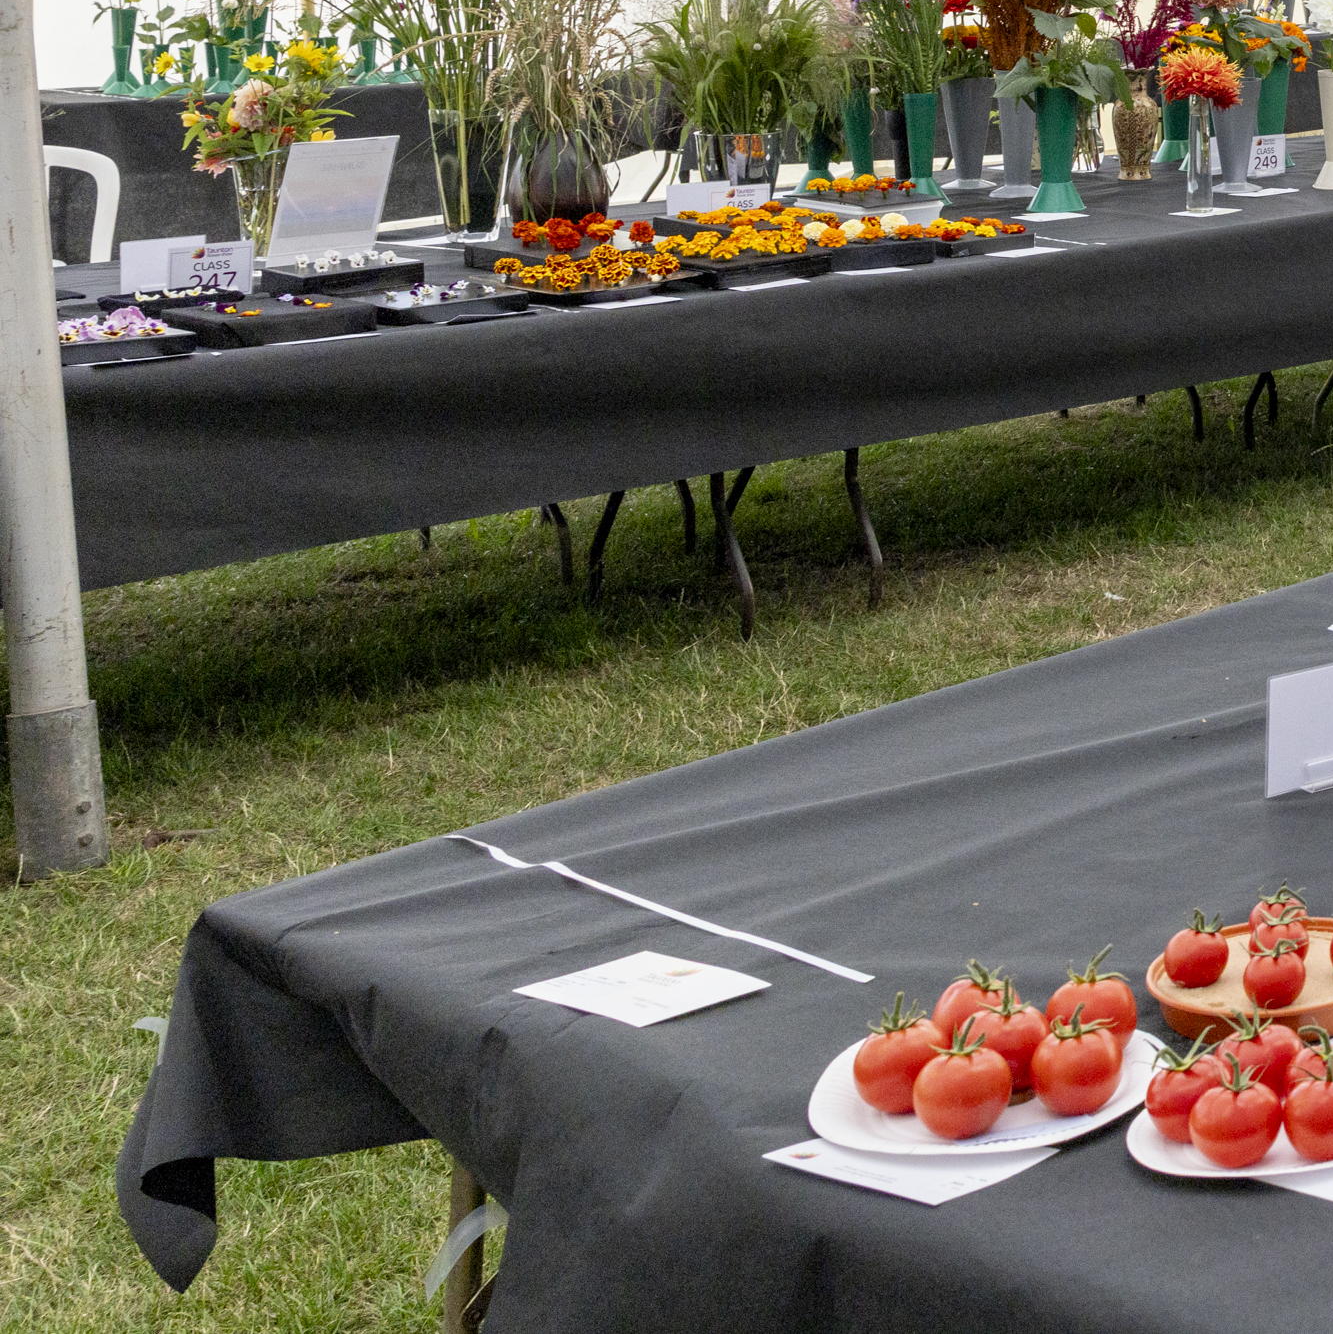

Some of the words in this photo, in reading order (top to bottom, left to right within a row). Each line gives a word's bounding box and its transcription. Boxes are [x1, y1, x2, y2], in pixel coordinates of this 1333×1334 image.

[1256, 147, 1275, 155] CLASS
[1254, 155, 1278, 170] 249
[726, 199, 754, 208] CLASS
[193, 259, 231, 271] CLASS
[189, 271, 237, 288] 247
